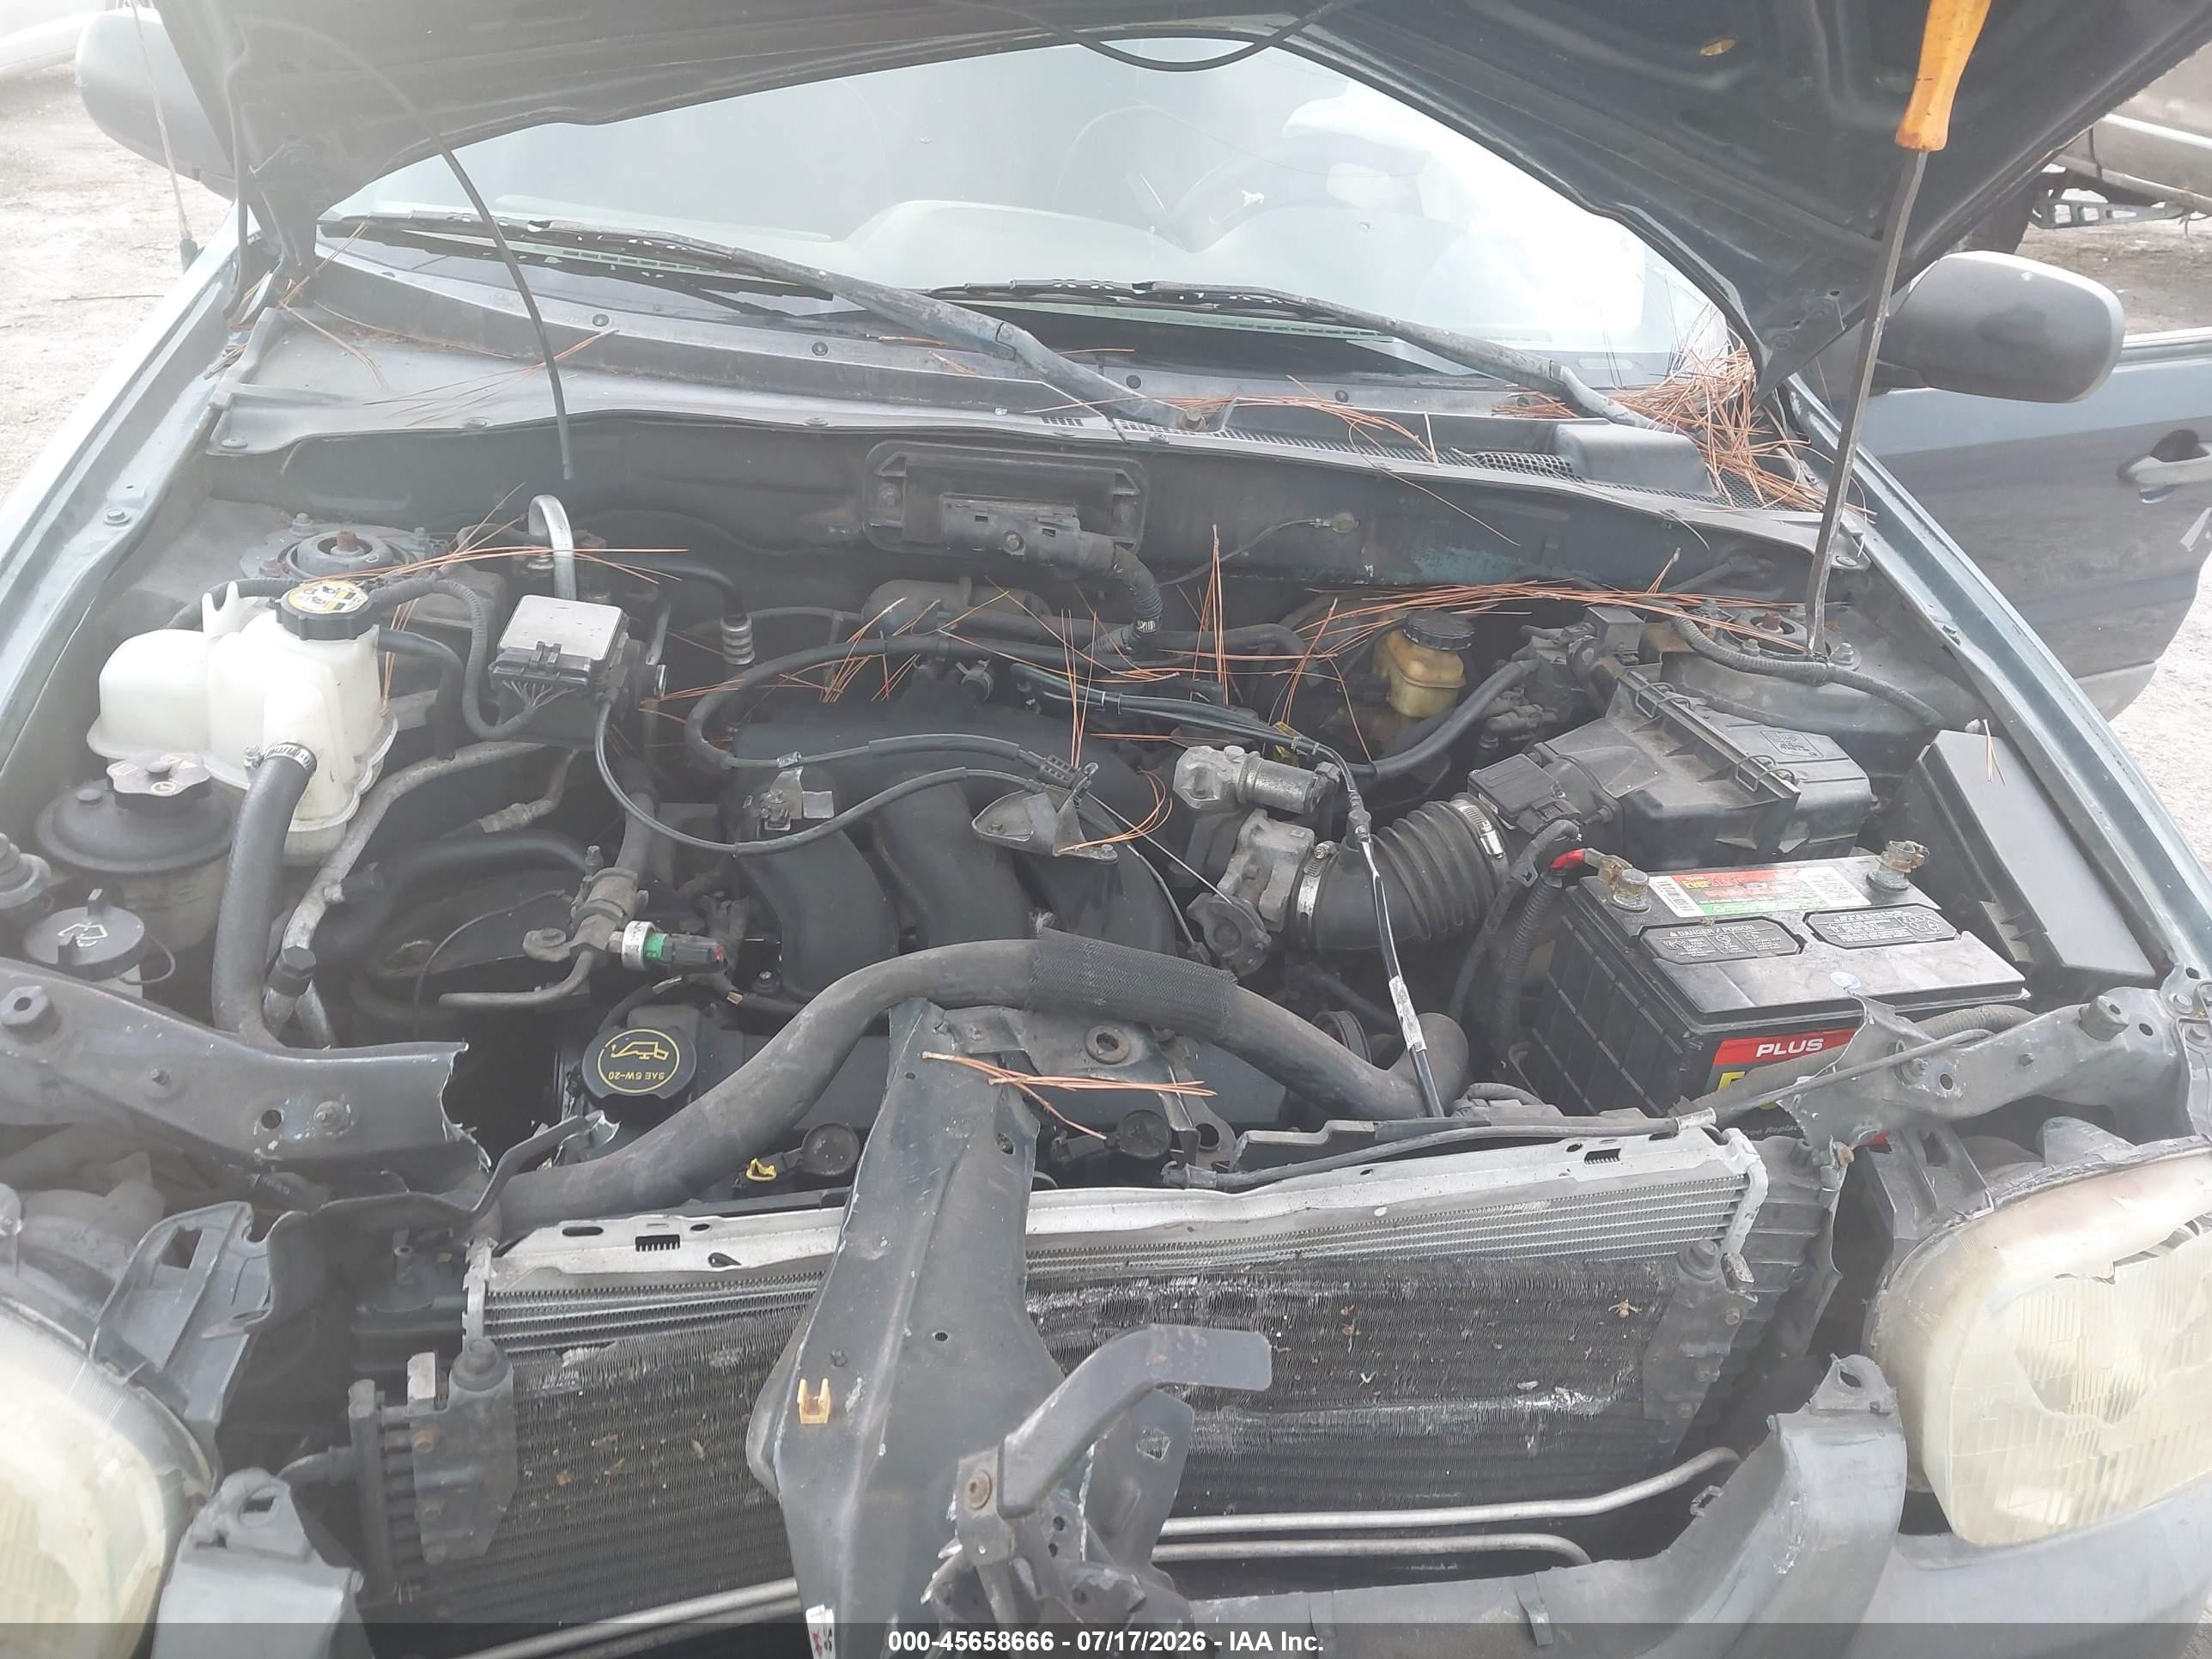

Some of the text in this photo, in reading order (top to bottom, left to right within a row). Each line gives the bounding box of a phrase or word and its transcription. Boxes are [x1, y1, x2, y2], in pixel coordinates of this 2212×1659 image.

[1675, 928, 1714, 938] DANGER
[1723, 924, 1756, 933] POISON
[1755, 1037, 1825, 1057] PLUS
[644, 1071, 665, 1080] SAE
[1765, 1124, 1802, 1134] Replac
